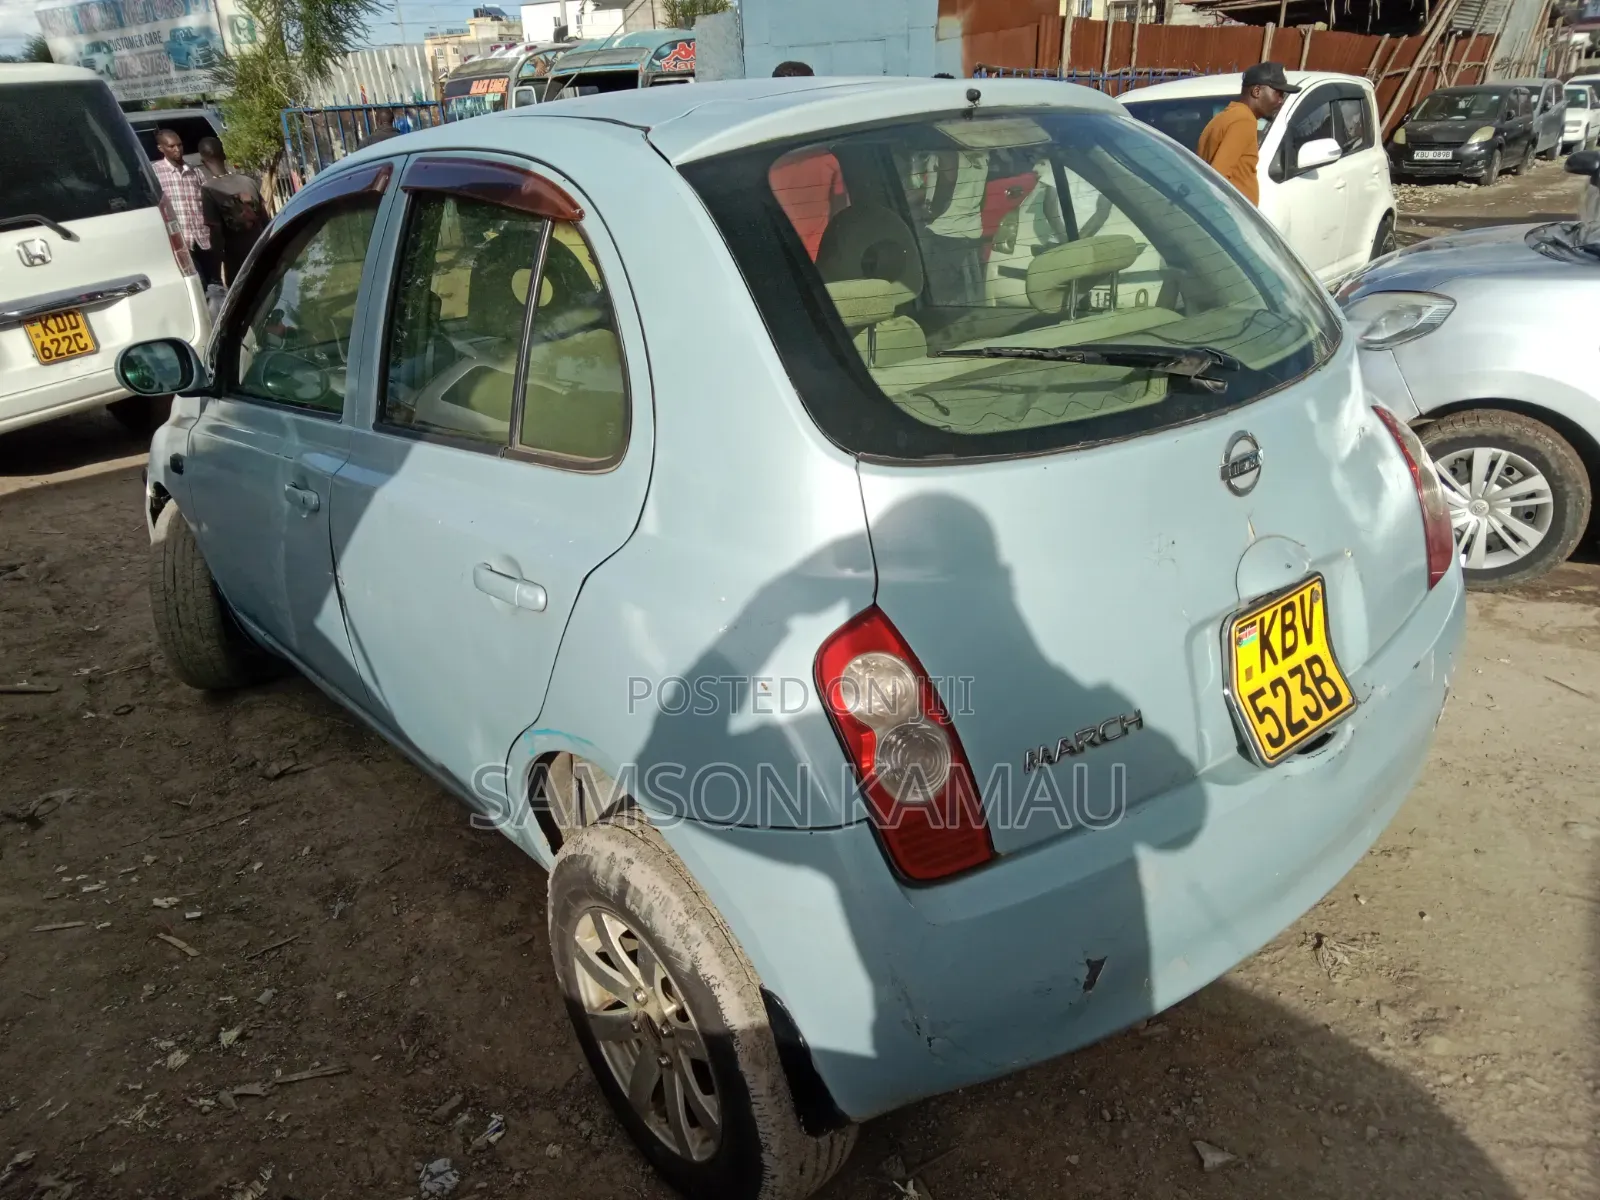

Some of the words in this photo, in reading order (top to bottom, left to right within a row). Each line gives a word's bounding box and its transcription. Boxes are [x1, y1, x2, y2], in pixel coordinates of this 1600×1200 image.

[107, 34, 144, 52] CUSTOMER
[144, 30, 163, 46] CARE
[470, 79, 490, 94] BLACK
[488, 78, 509, 93] EAGLE
[39, 311, 81, 336] KDD
[40, 333, 89, 360] 622C
[1259, 587, 1315, 674] KBV
[1248, 654, 1343, 749] 523B
[1023, 708, 1144, 774] MARCH
